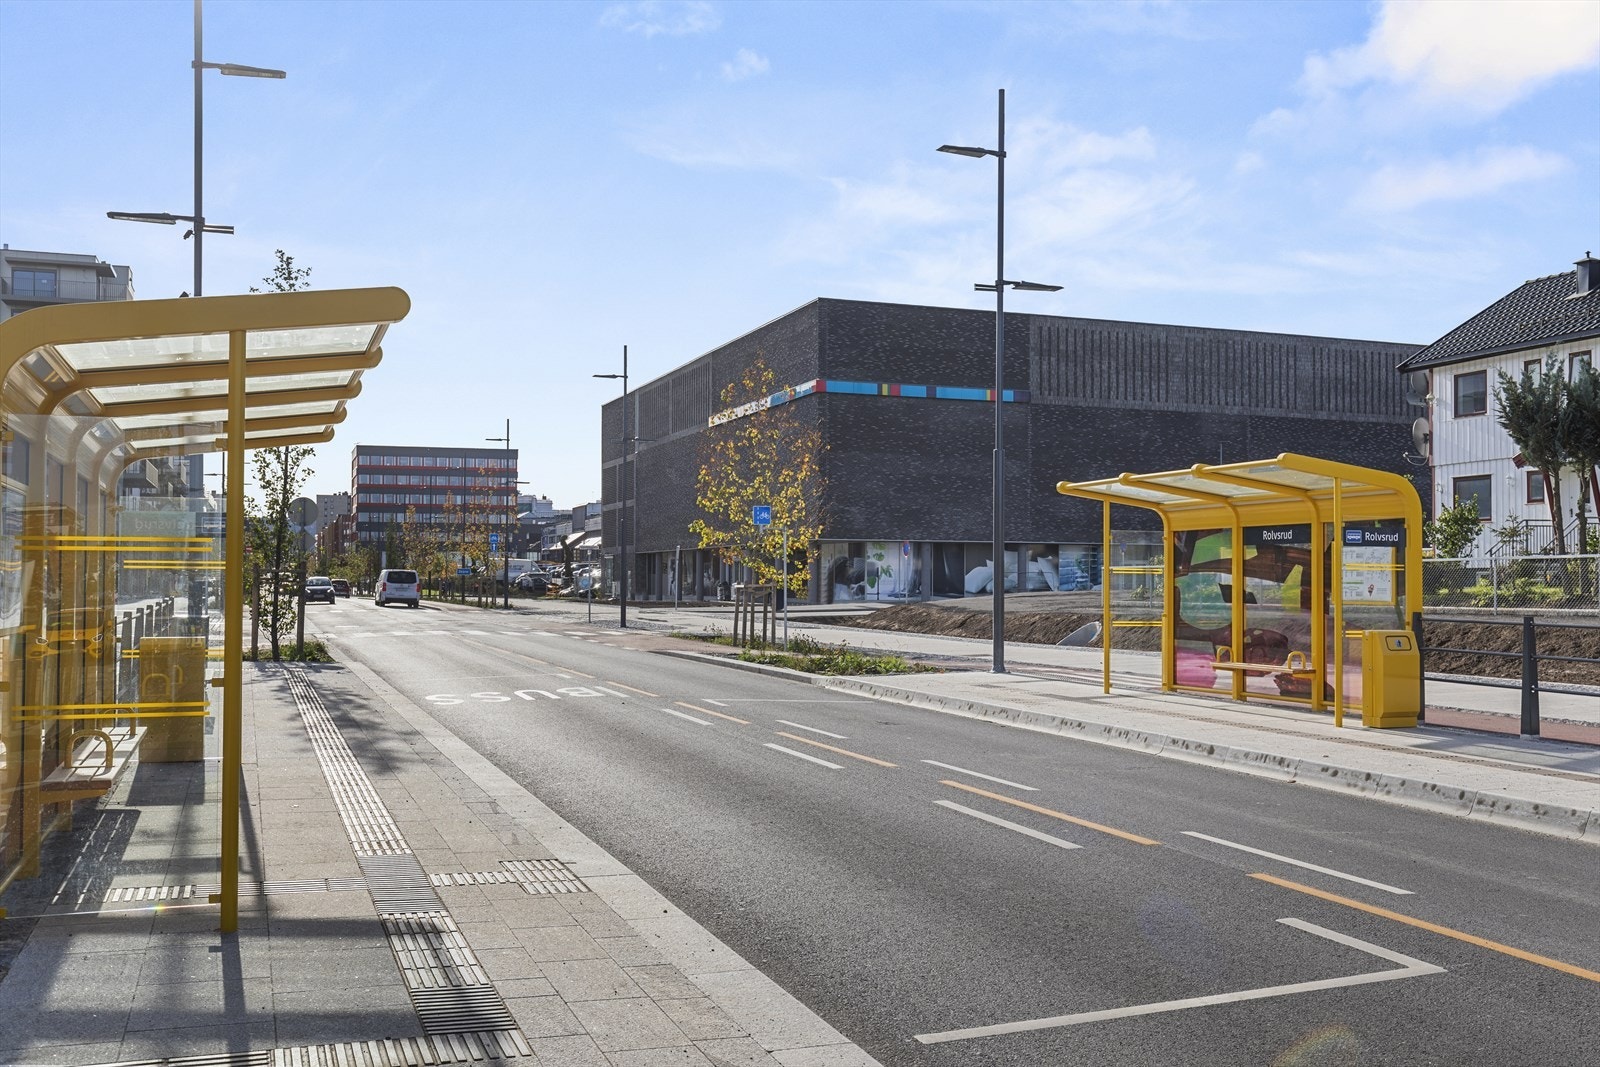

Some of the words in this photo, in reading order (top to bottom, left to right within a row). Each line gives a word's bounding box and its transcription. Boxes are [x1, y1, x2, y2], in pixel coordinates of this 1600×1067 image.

[1262, 529, 1293, 541] Rolvsrud
[1365, 531, 1399, 542] Rolvsrud
[425, 686, 630, 705] BUSS
